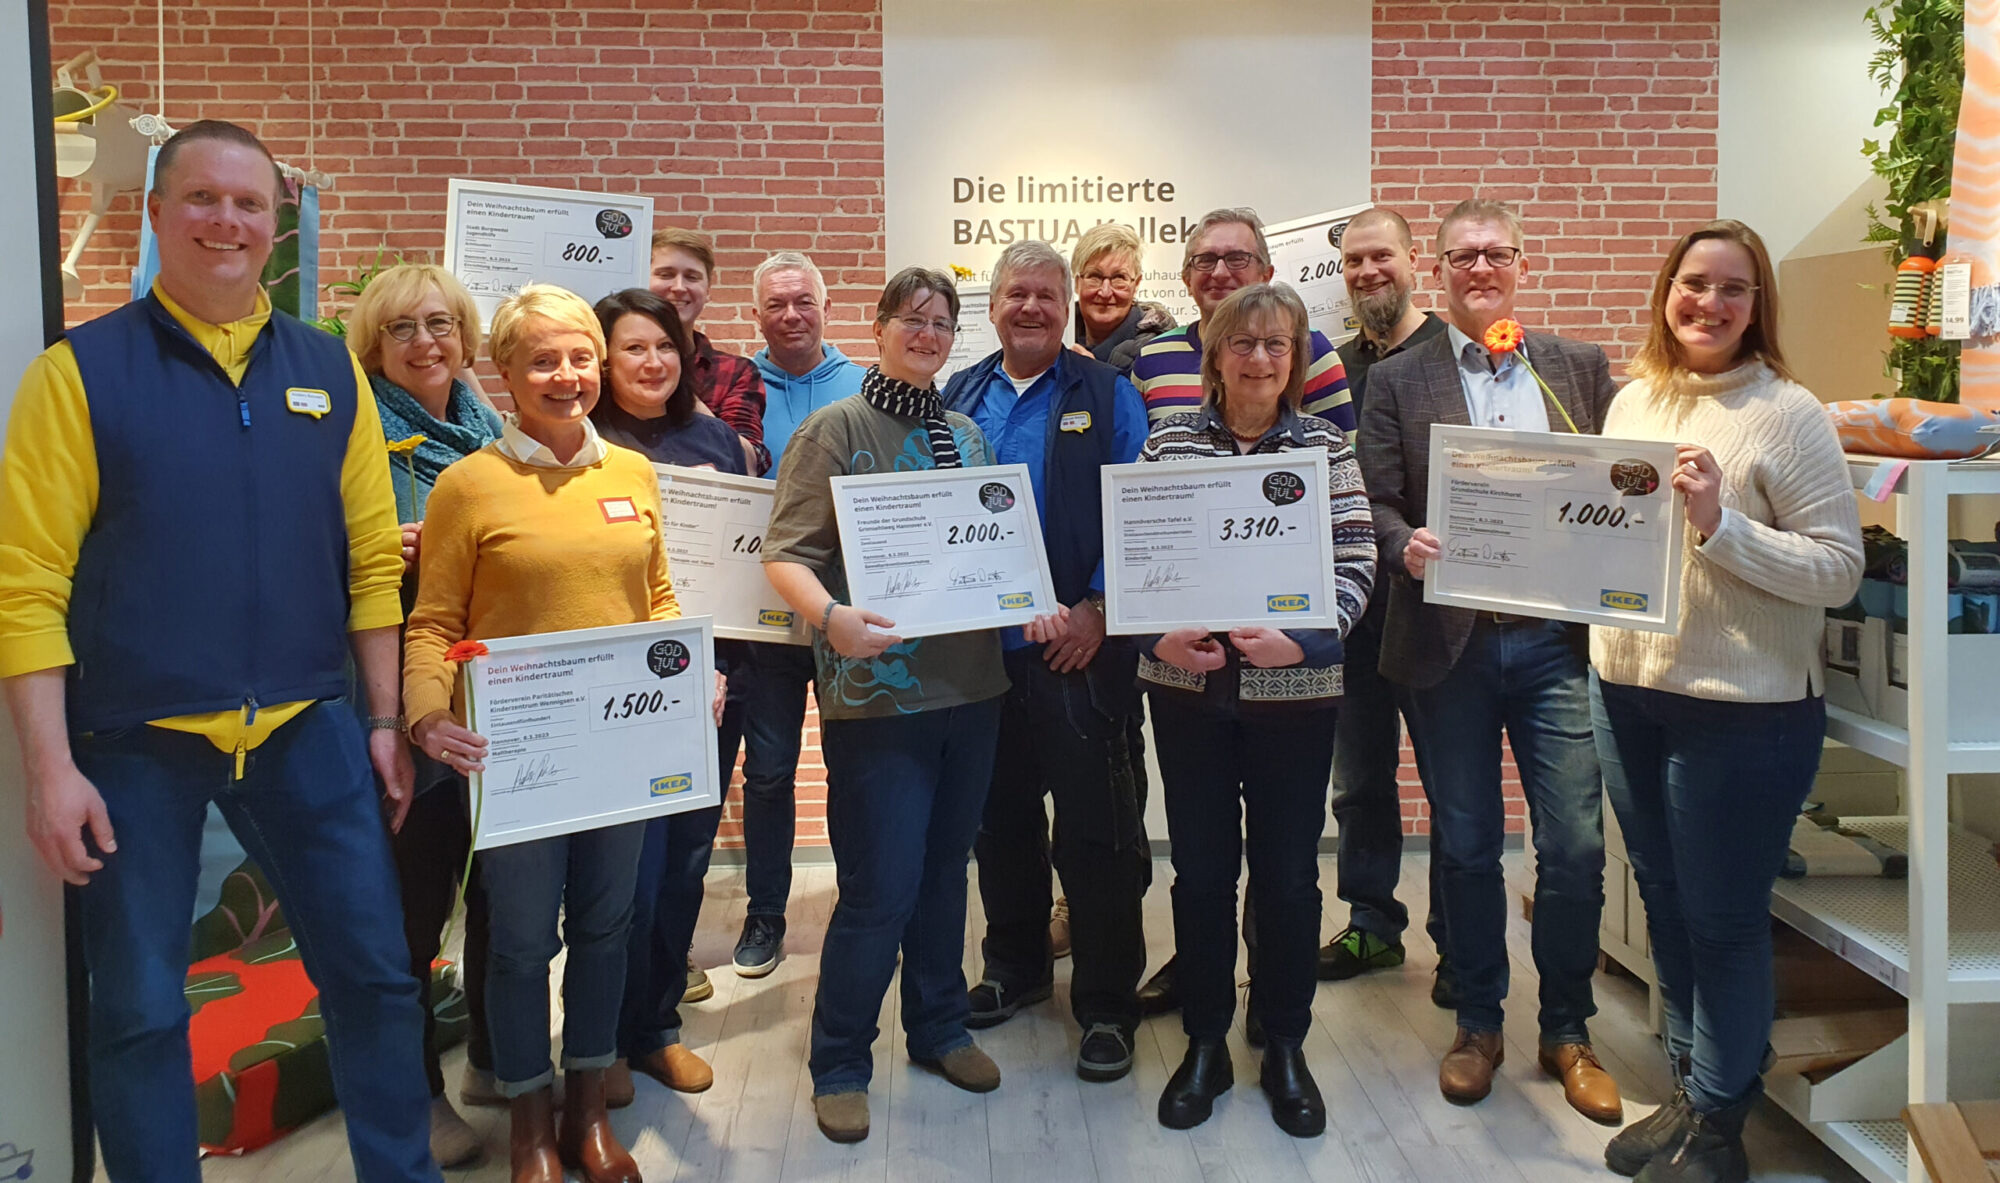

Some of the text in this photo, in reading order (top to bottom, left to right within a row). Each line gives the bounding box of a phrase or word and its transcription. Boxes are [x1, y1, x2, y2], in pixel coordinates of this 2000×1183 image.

[953, 176, 1175, 203] Die limitierte
[485, 203, 546, 214] Weihnachtsbaum
[488, 211, 535, 220] Kindertraum!
[601, 211, 627, 225] GOD
[600, 220, 622, 234] JUL
[953, 217, 1198, 245] BASTUA llek
[562, 242, 614, 264] 800.-
[1143, 269, 1183, 281] uhaus
[1152, 289, 1175, 298] von
[1451, 461, 1474, 469] einen
[1140, 483, 1206, 493] Weihnachtsbaum
[1207, 481, 1231, 489] erfüllt
[1268, 474, 1298, 488] GOD
[668, 488, 729, 503] Weihnachtsbaum
[730, 497, 751, 506] erfüllt
[983, 485, 1008, 497] GOD
[1268, 485, 1294, 500] JUL
[1450, 486, 1488, 495] Grundschule
[670, 497, 717, 509] Kindertraum!
[853, 491, 953, 504] Dein Weihnachtsbaum erfüllt
[984, 495, 1007, 508] JUL
[1144, 493, 1194, 502] Kindertraum!
[875, 501, 922, 511] Kindertraum!
[1558, 502, 1645, 529] 1.000.-
[947, 522, 1015, 545] 2.000.-
[1219, 516, 1297, 541] 3.310.-
[1001, 596, 1030, 606] IKEA
[1271, 599, 1306, 608] IKEA
[1605, 594, 1643, 606] IKEA
[762, 613, 790, 622] IKEA
[653, 643, 683, 657] GOD
[487, 653, 615, 675] Dein Weihnachtsbaum erfüllt
[653, 656, 679, 672] JUL
[488, 668, 574, 686] einen Kindertraum!
[490, 690, 574, 706] Förderverein Paritätisches
[490, 702, 539, 713] Kinderzentrum
[603, 690, 681, 721] 1.500.-
[653, 778, 689, 792] IKEA
